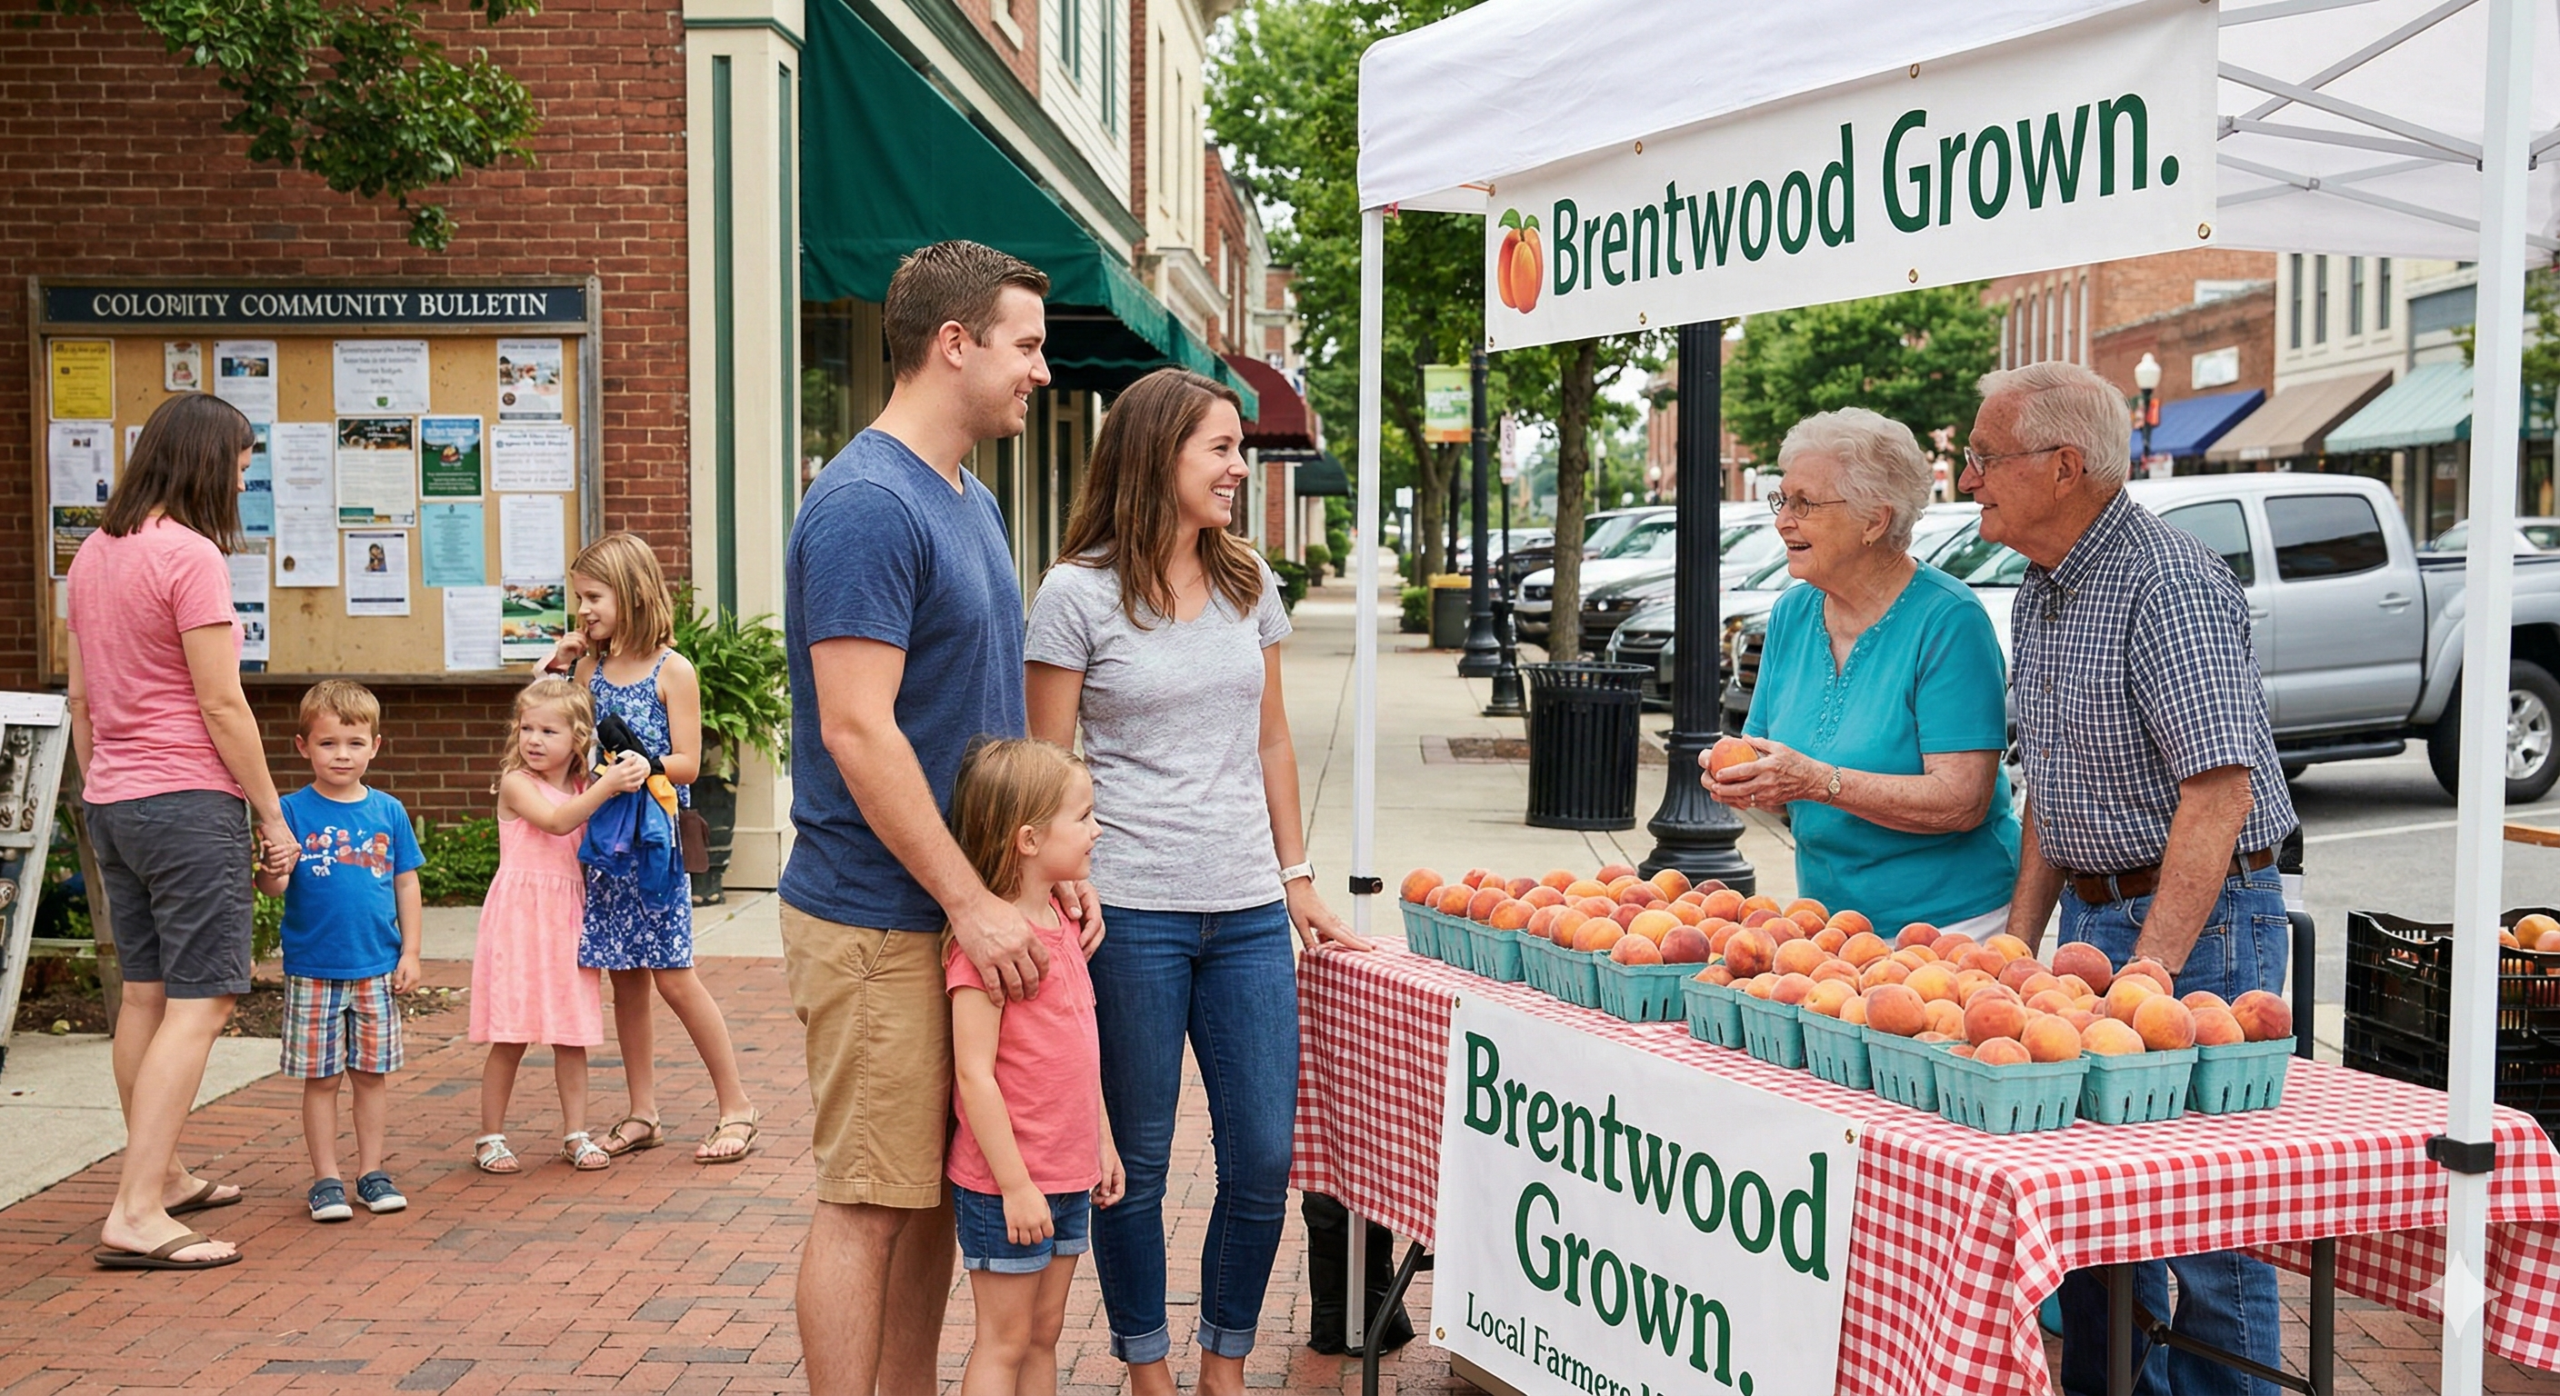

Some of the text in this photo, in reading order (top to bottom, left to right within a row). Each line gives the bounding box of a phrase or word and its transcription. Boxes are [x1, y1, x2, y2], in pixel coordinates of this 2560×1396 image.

[1553, 93, 2180, 297] Brentwood Grown.
[240, 293, 408, 317] COMMUNITY
[418, 292, 549, 317] BULLETIN
[1464, 1031, 1831, 1283] Brentwood
[1466, 1291, 1526, 1357] Local
[1515, 1181, 1754, 1396] Grown.
